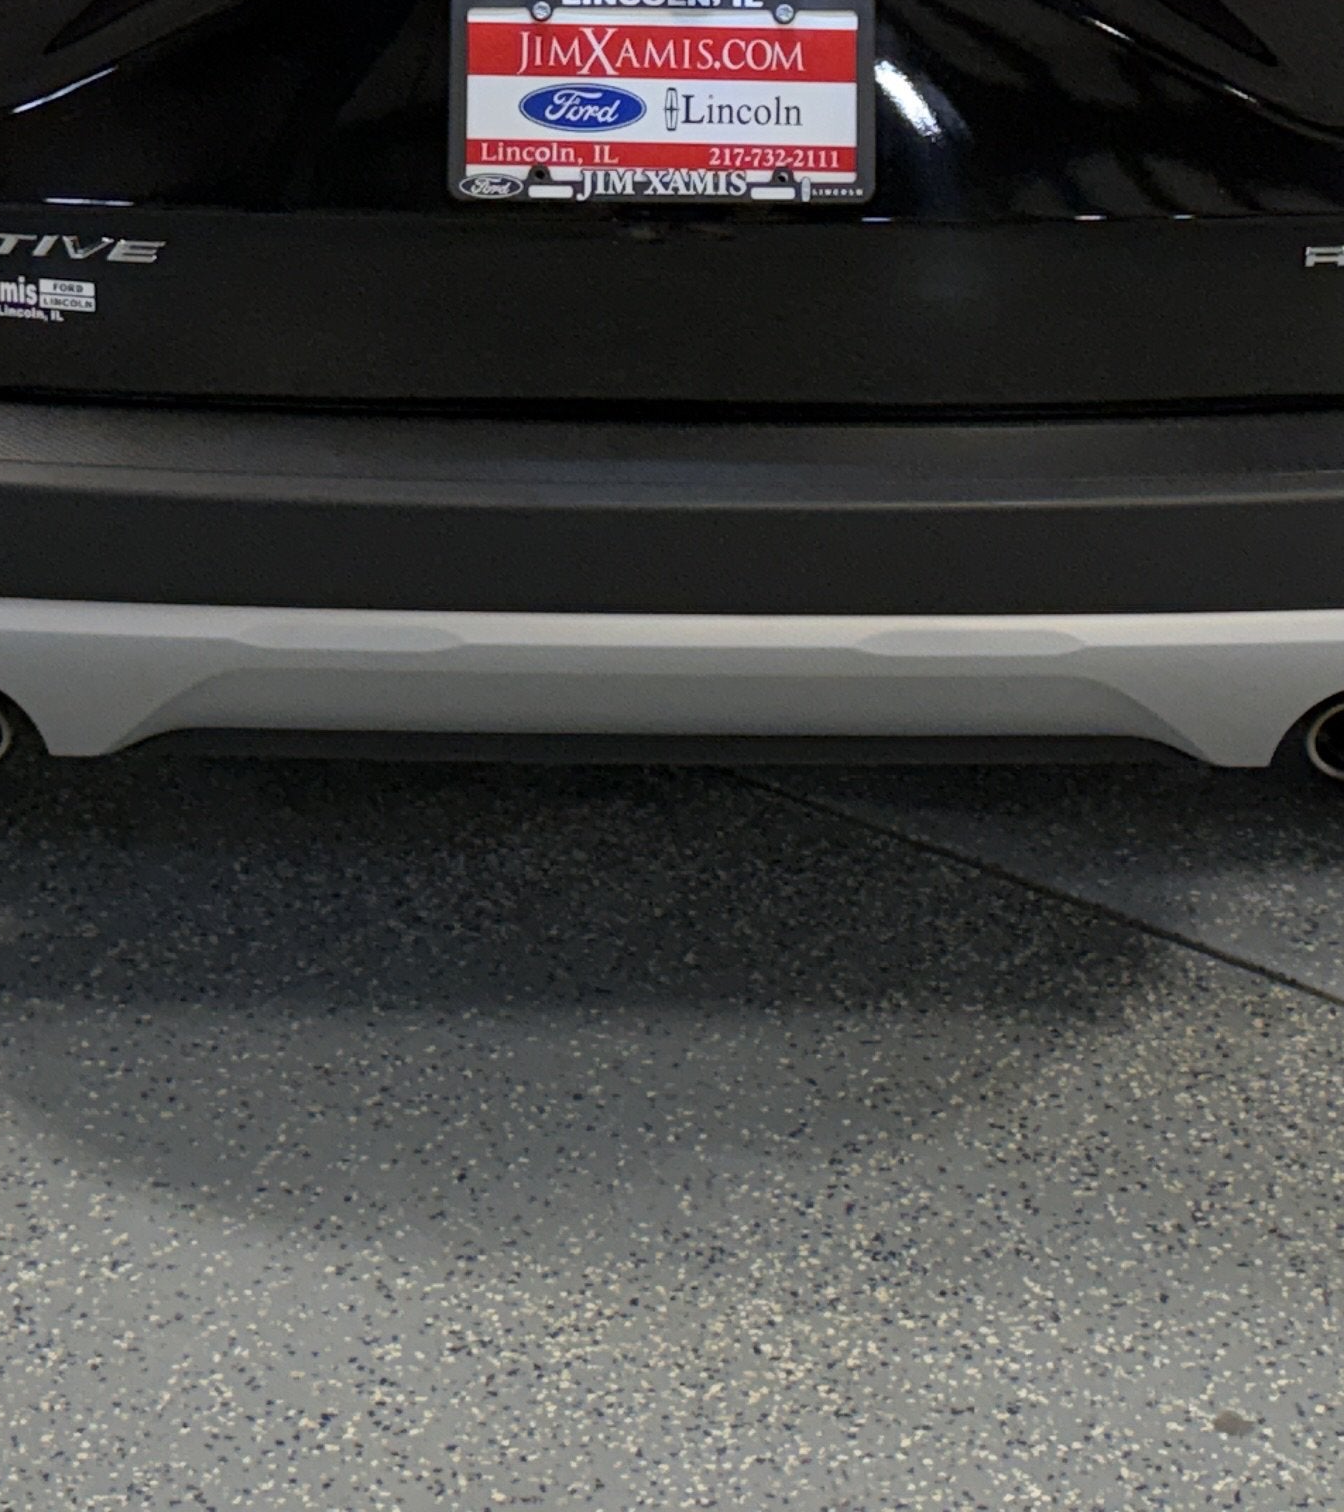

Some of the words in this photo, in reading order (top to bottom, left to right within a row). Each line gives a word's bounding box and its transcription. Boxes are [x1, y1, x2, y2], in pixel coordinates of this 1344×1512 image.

[517, 28, 806, 76] JIMXAMIS.COM
[544, 89, 621, 124] Ford
[681, 94, 803, 127] Lincoln
[480, 143, 583, 167] Lincoln,
[593, 146, 619, 164] IL
[709, 148, 840, 168] 217-732-2111
[576, 169, 636, 201] JIM
[644, 170, 748, 197] XAMIS
[52, 283, 84, 294] FORD
